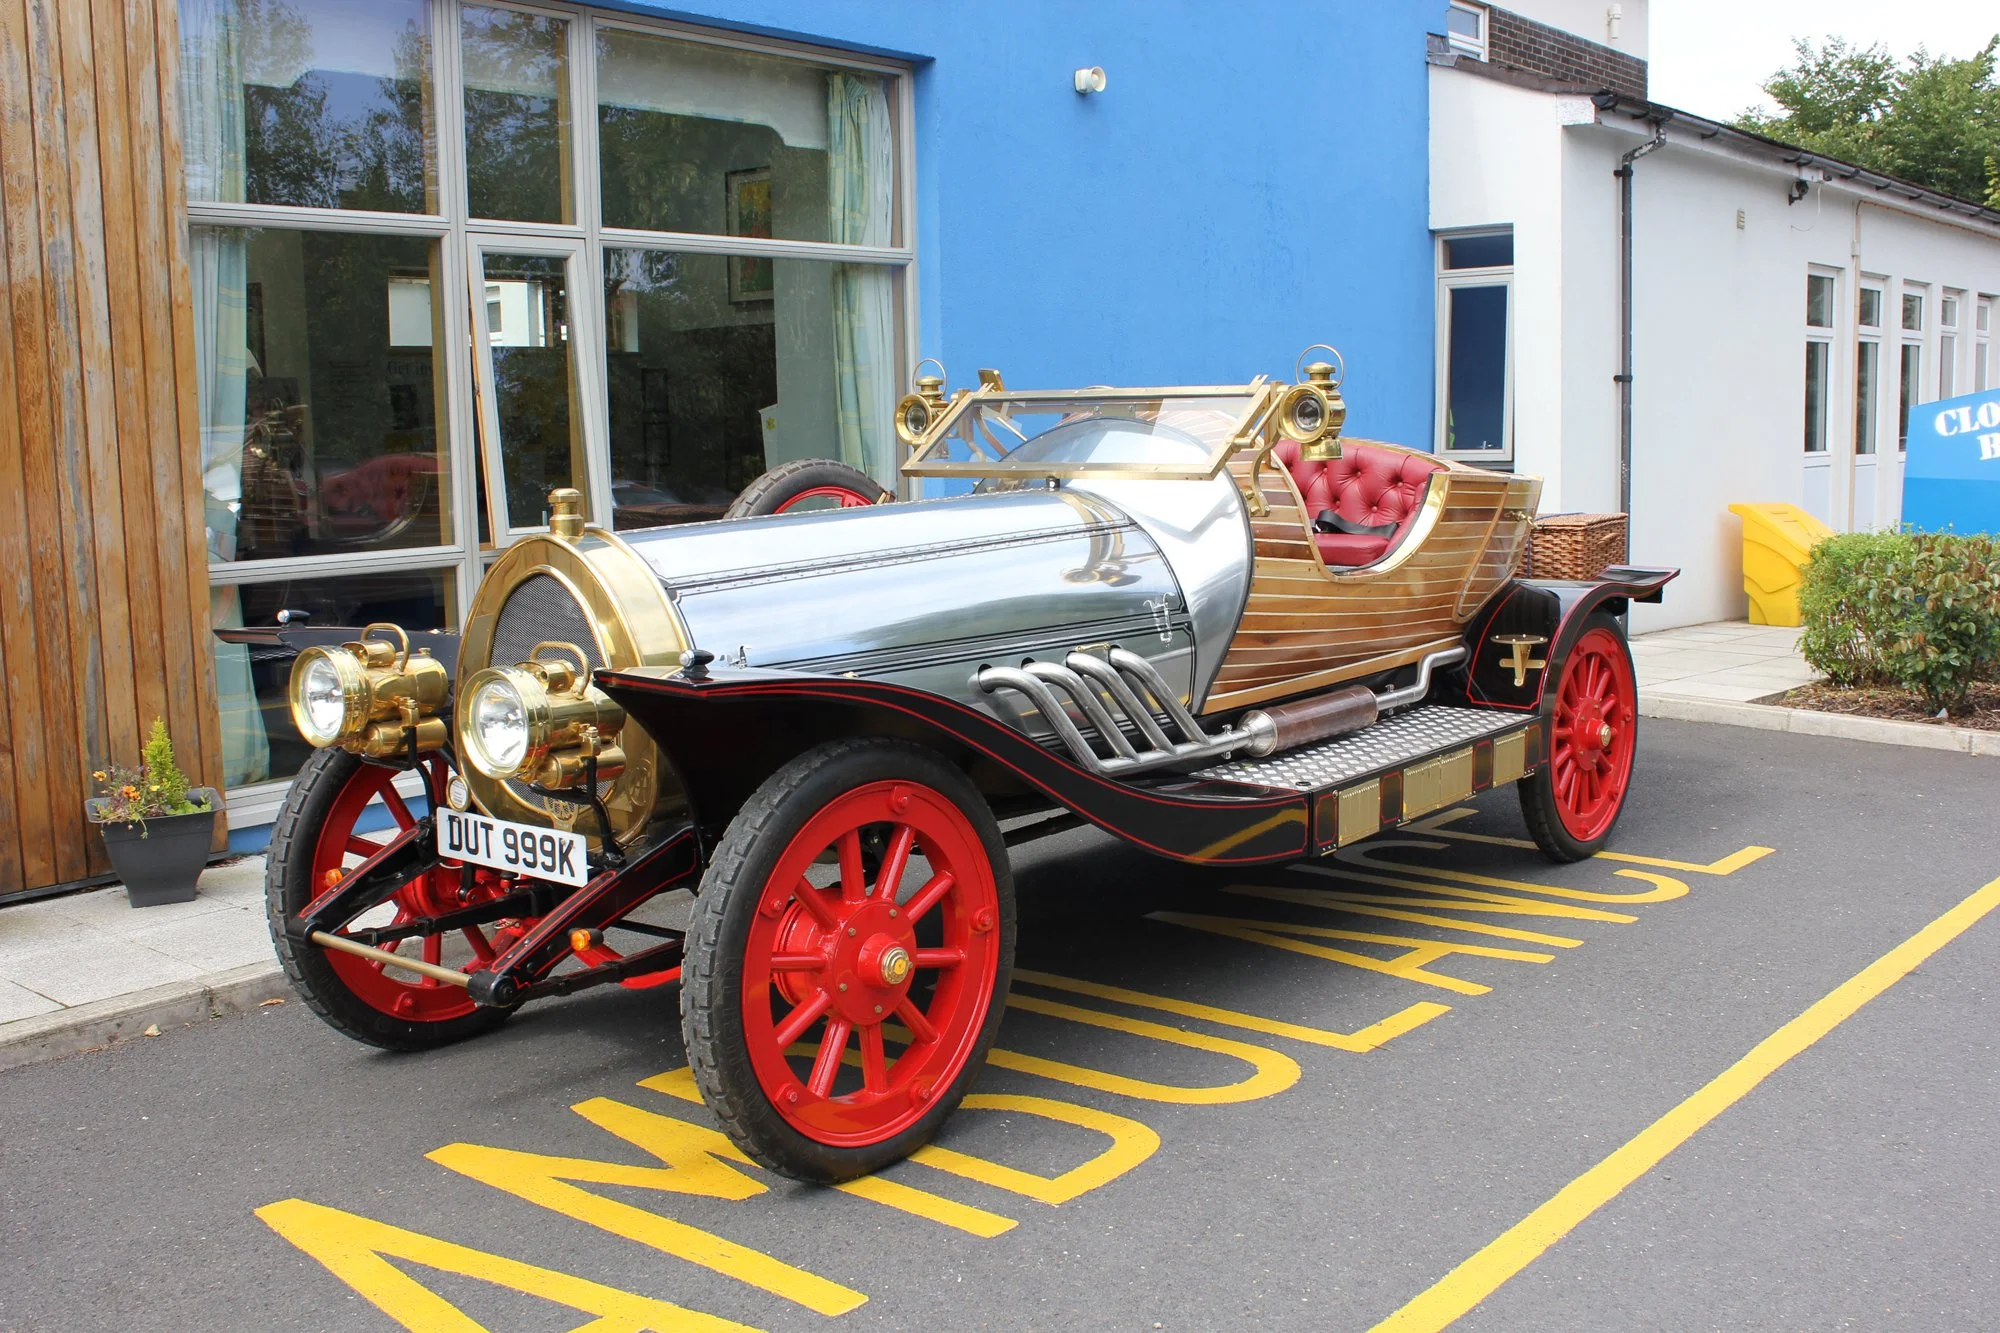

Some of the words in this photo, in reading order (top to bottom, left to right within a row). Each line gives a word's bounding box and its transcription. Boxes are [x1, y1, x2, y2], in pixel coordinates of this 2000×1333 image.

[448, 814, 494, 859] DUT
[503, 827, 576, 878] 999K
[722, 956, 769, 1124] MICHELIN
